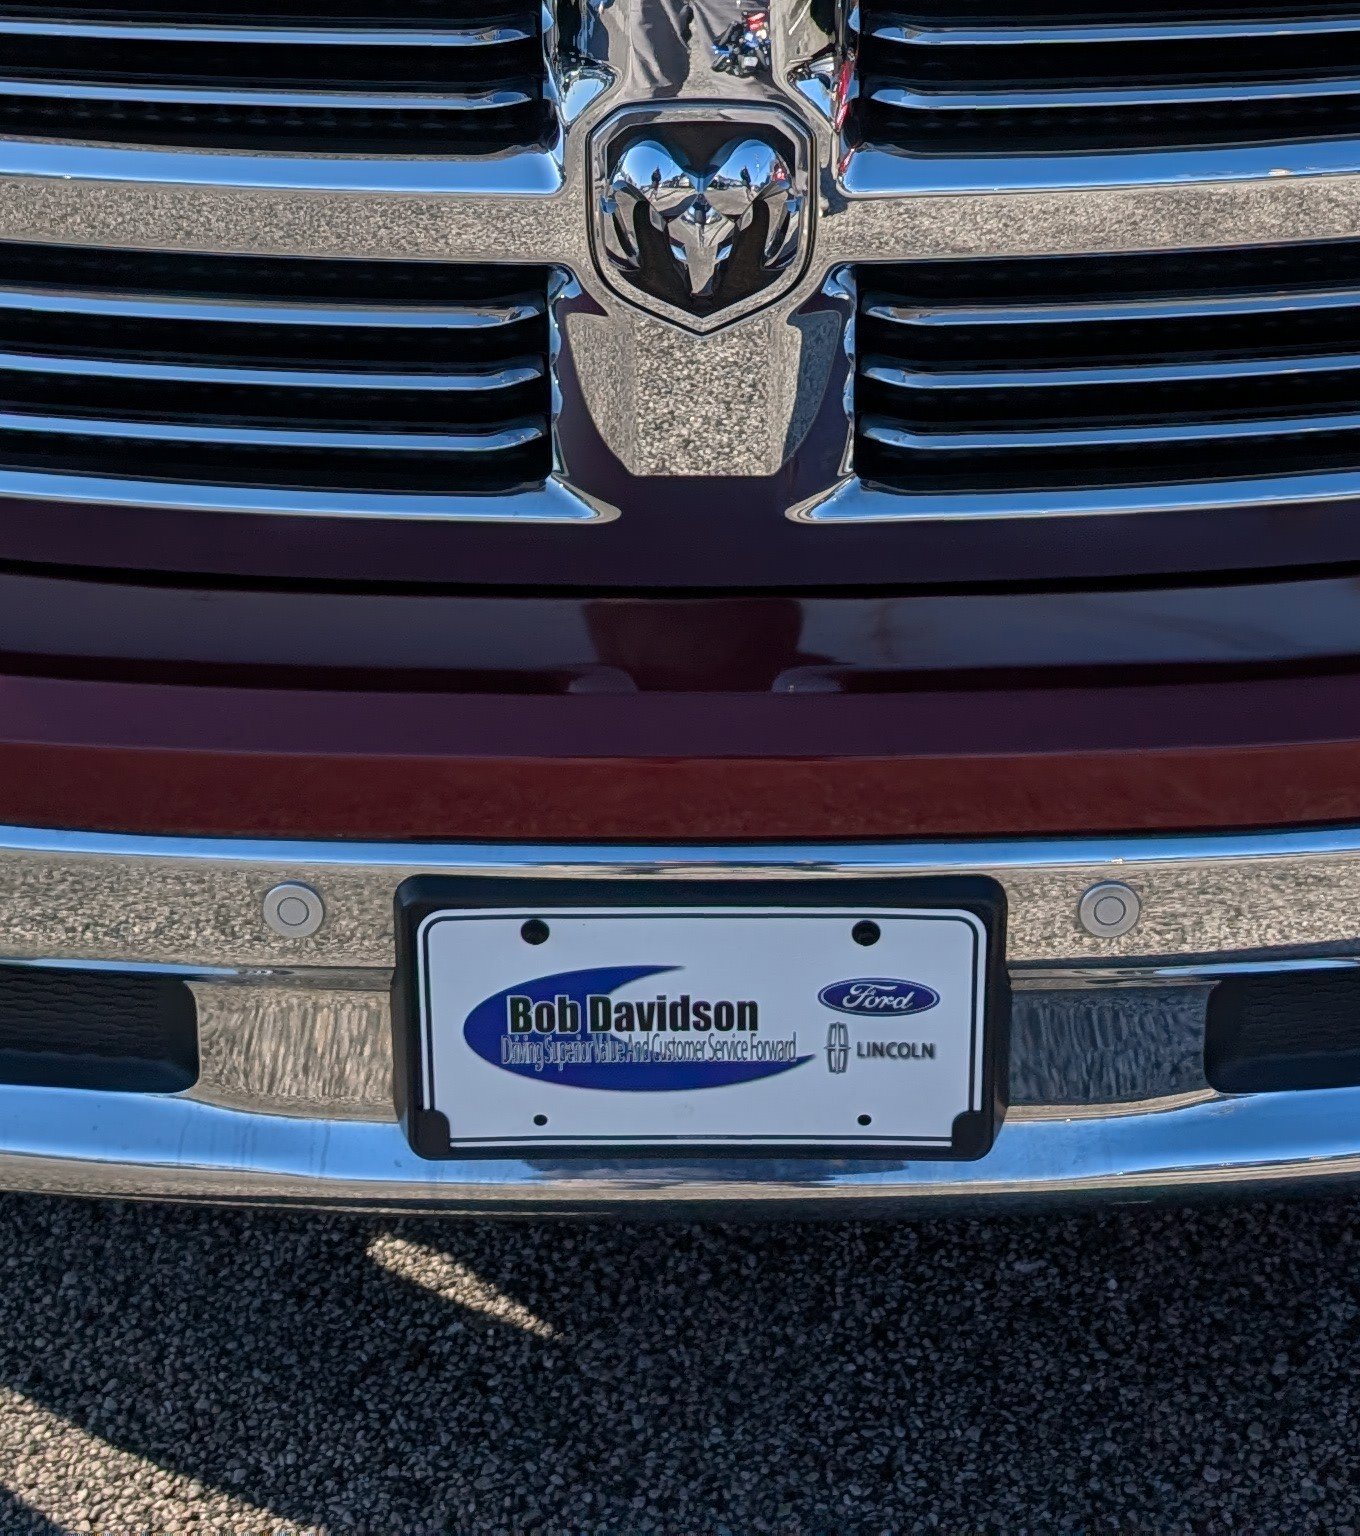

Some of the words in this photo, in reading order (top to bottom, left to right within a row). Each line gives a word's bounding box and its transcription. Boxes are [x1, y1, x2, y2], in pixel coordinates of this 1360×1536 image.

[842, 982, 914, 1010] Ford
[508, 995, 581, 1034] Bob
[588, 995, 759, 1033] Davidson
[501, 1034, 544, 1072] Driving
[544, 1034, 593, 1071] Superior
[593, 1032, 626, 1063] Value
[625, 1033, 651, 1063] And
[651, 1032, 707, 1062] Customer
[707, 1032, 749, 1062] Service
[749, 1030, 798, 1062] Forward
[856, 1041, 936, 1060] LINCOLN
